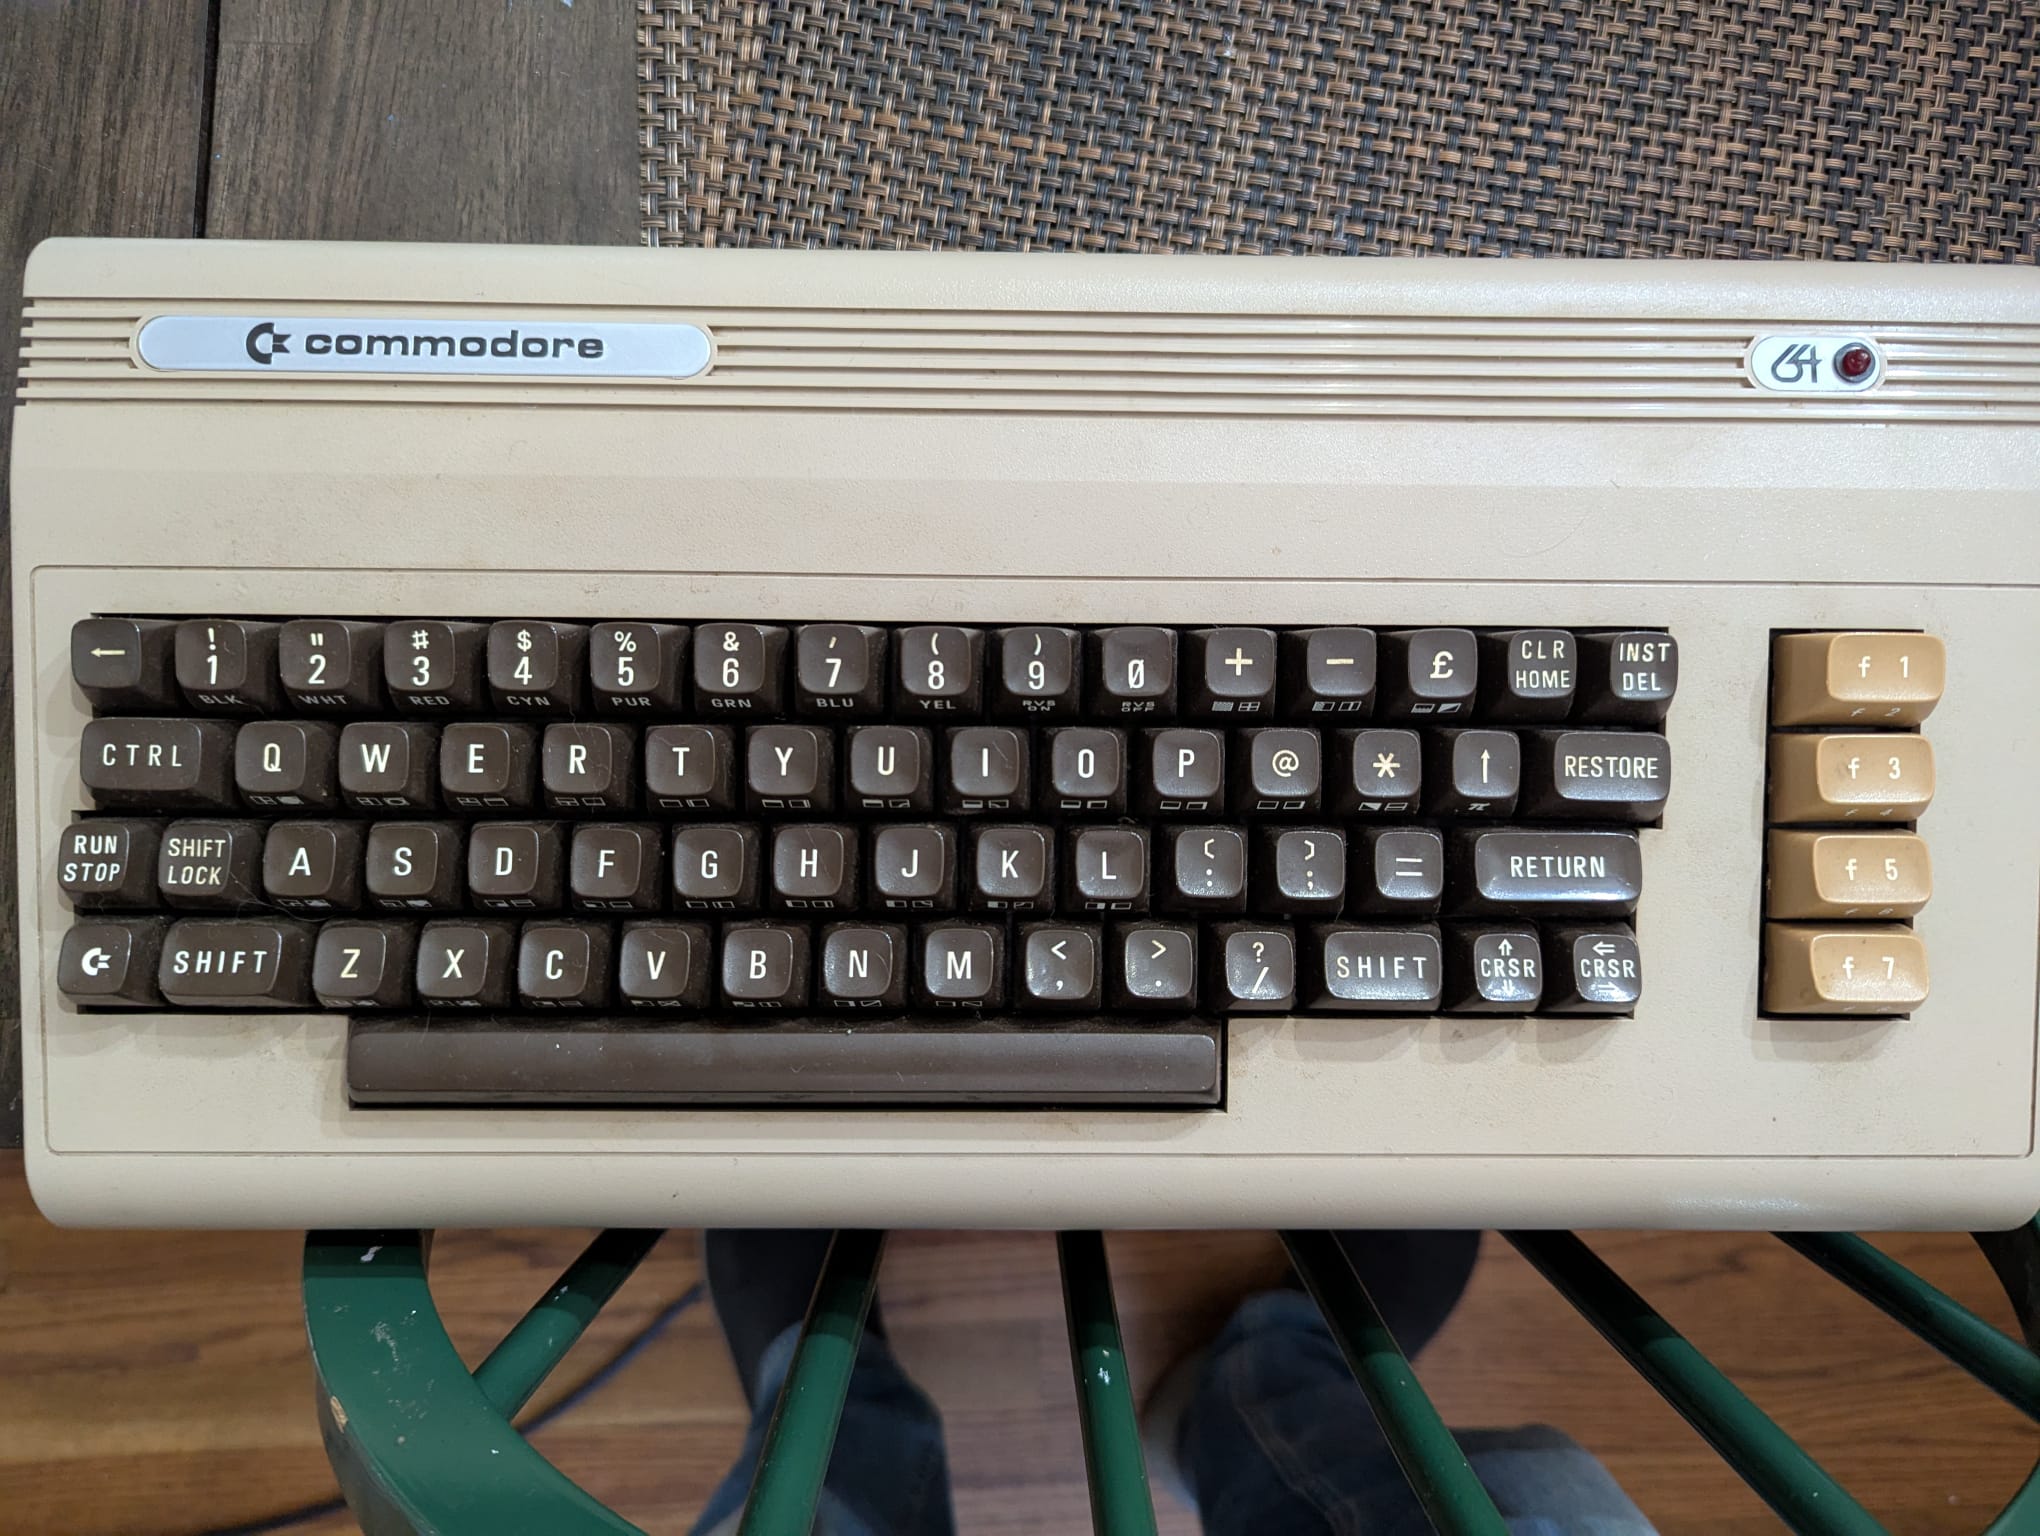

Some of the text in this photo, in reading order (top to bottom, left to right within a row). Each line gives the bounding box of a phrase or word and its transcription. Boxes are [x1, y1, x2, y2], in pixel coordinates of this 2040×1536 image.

[305, 329, 604, 359] commodore
[1771, 344, 1822, 383] 64
[517, 629, 532, 652] $
[614, 631, 637, 653] %
[722, 631, 740, 652] &
[1521, 639, 1565, 660] CLR
[1619, 642, 1671, 663] INST
[207, 654, 218, 685] 1
[308, 654, 326, 684] 2
[412, 655, 430, 686] 3
[513, 656, 533, 685] 4
[617, 656, 634, 687] 5
[722, 657, 739, 688] 6
[825, 658, 842, 688] 7
[927, 660, 945, 690] 8
[1028, 660, 1045, 690] 9
[1429, 650, 1454, 679] £
[1516, 670, 1570, 689] HOME
[1622, 672, 1661, 691] DEL
[199, 695, 244, 704] BLK
[298, 695, 347, 705] WHT
[409, 695, 450, 705] RED
[506, 695, 550, 706] CYN
[611, 696, 651, 706] PUR
[711, 698, 752, 708] GRN
[816, 698, 854, 708] BLU
[919, 700, 955, 710] YEL
[102, 743, 182, 767] CTRL
[263, 743, 282, 772] Q
[361, 743, 391, 773] W
[468, 743, 485, 774] E
[569, 744, 587, 774] R
[672, 747, 690, 776] T
[774, 747, 794, 776] Y
[877, 746, 895, 776] U
[1178, 748, 1195, 778] P
[1272, 749, 1299, 778] @
[1565, 755, 1658, 779] RESTORE
[74, 835, 117, 855] RUN
[167, 838, 226, 858] SHIFT
[63, 862, 120, 882] STOP
[167, 865, 222, 885] LOCK
[288, 847, 311, 876] A
[393, 846, 412, 876] S
[495, 847, 513, 876] D
[598, 849, 615, 878] F
[701, 850, 718, 879] G
[800, 848, 818, 878] H
[901, 849, 918, 878] J
[1001, 850, 1019, 878] K
[1101, 851, 1117, 880] L
[1510, 856, 1605, 878] RETURN
[173, 950, 268, 974] SHIFT
[340, 948, 361, 979] Z
[442, 949, 465, 978] X
[545, 949, 564, 980] C
[647, 951, 666, 980] V
[749, 950, 767, 979] B
[848, 949, 868, 978] N
[947, 951, 972, 980] M
[1252, 941, 1265, 963] ?
[1336, 956, 1427, 979] SHIFT
[1480, 958, 1536, 978] CRSR
[1580, 958, 1636, 978] CRSR
